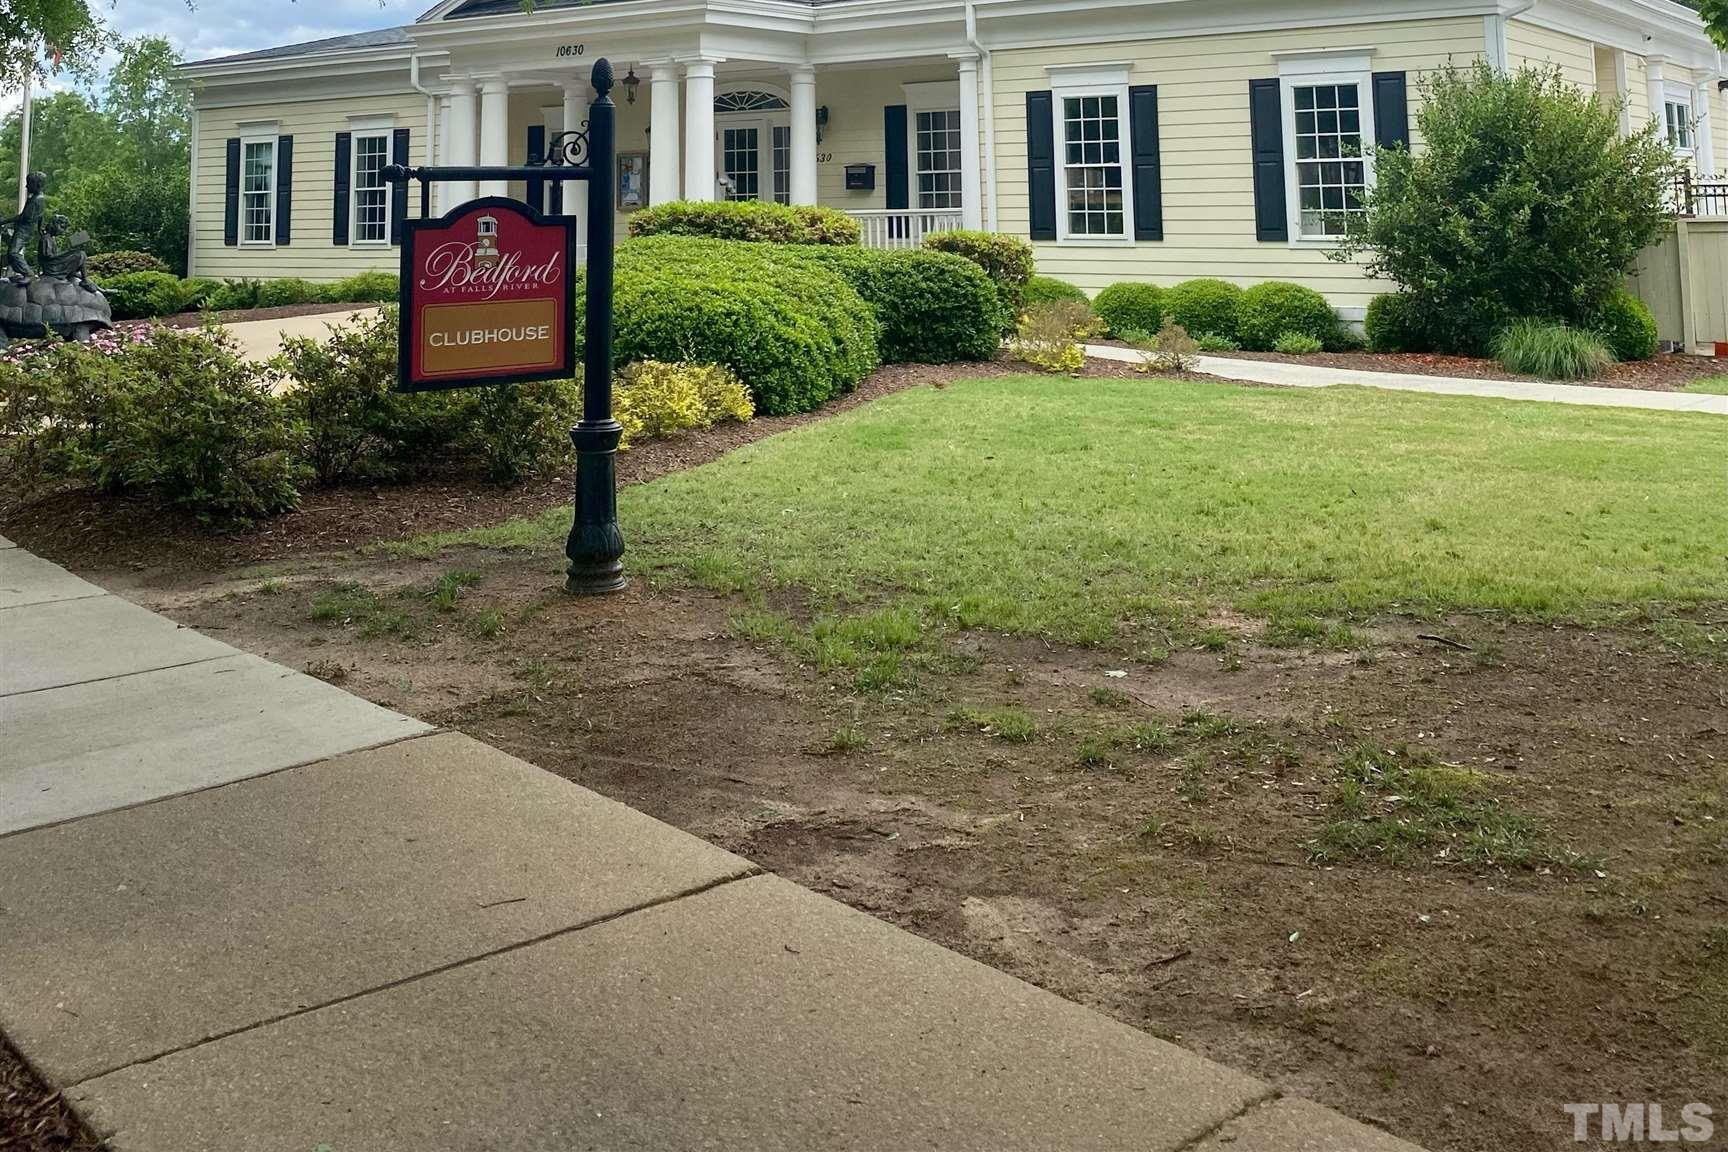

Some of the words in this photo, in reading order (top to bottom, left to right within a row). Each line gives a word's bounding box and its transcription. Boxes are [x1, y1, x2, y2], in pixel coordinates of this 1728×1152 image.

[556, 44, 584, 57] 10630
[420, 241, 560, 300] Bedford
[461, 285, 493, 293] FALLS
[502, 282, 539, 291] RIVER
[429, 325, 550, 347] CLUBHOUSE
